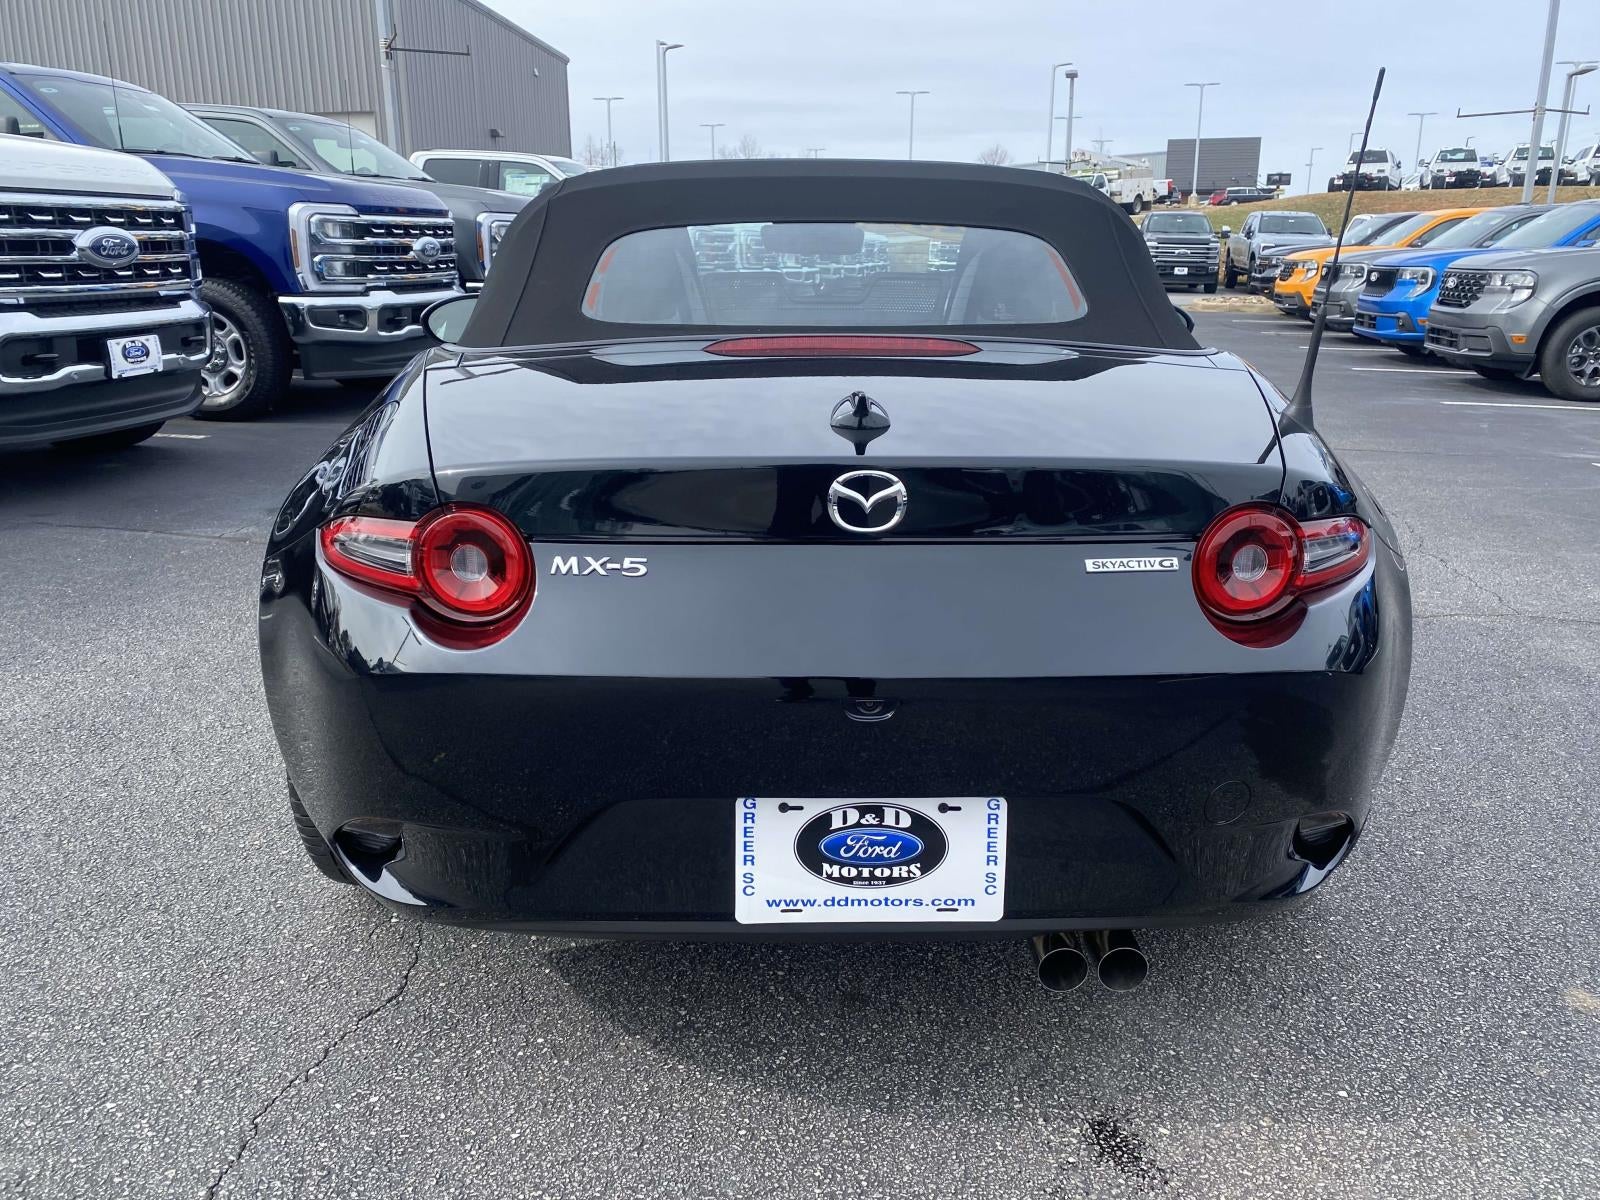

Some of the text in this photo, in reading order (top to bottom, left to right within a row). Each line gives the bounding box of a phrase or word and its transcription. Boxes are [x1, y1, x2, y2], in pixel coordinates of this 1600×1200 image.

[100, 238, 129, 256] Ford
[550, 556, 648, 577] MX-5
[829, 806, 912, 830] D&D
[742, 798, 756, 896] GREER SC
[840, 834, 903, 858] Ford
[984, 798, 1000, 896] GREER SC
[822, 862, 922, 878] MOTORS
[765, 896, 976, 908] www.ddmotors.com
